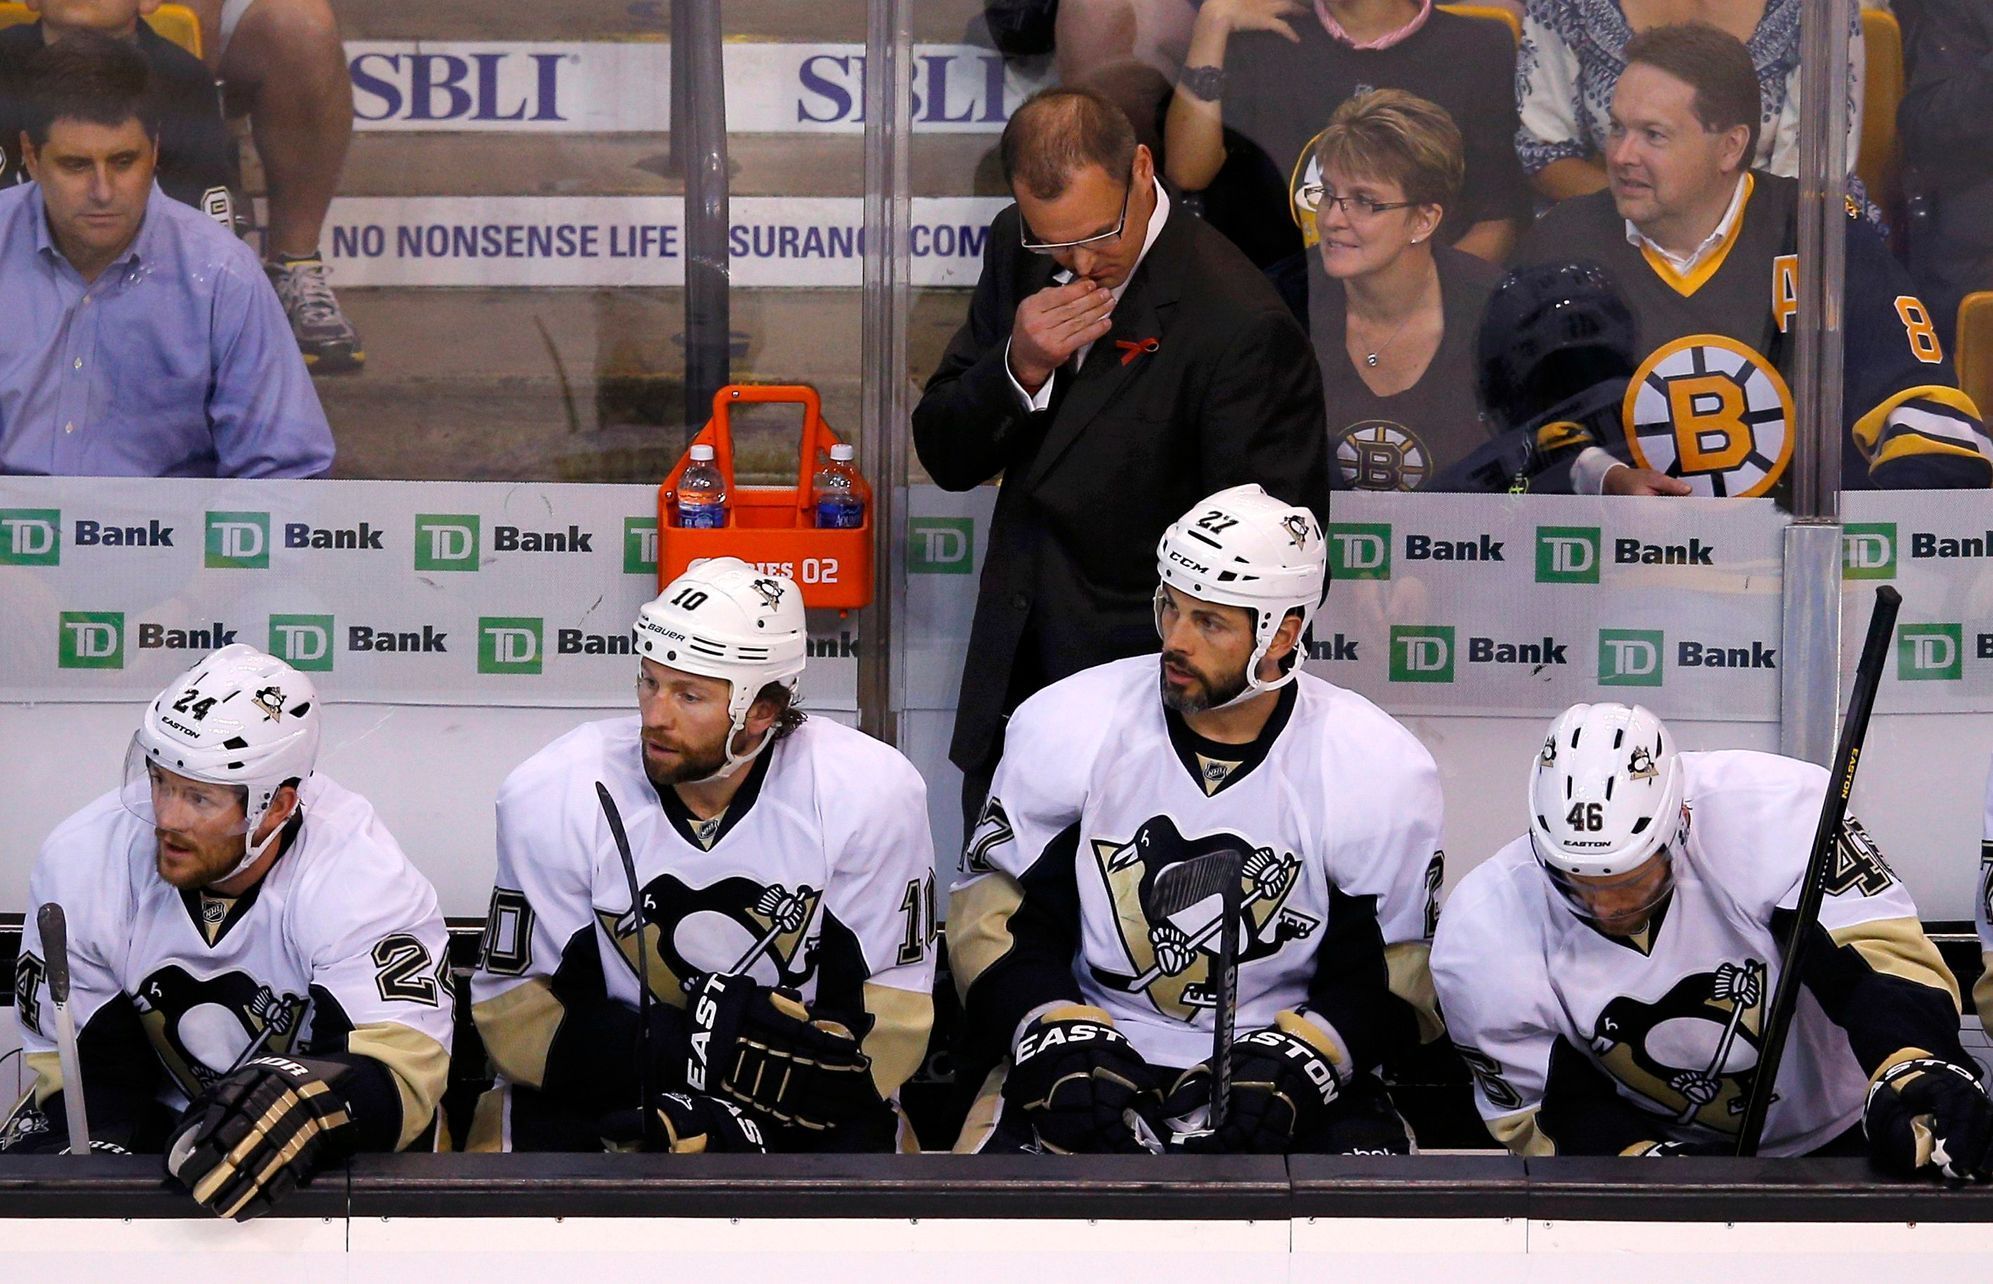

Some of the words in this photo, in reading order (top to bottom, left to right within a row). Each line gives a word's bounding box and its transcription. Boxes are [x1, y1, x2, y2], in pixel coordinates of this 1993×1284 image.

[350, 53, 568, 121] SBLI
[332, 225, 386, 257] NO
[397, 224, 599, 257] NONSENSE
[609, 225, 678, 257] LIFE
[1893, 296, 1943, 364] 8
[1, 519, 54, 554] TD
[75, 520, 174, 548] Bank
[1196, 510, 1240, 535] 27
[212, 523, 264, 558] TD
[285, 523, 384, 550] Bank
[422, 526, 473, 561] TD
[494, 526, 593, 553] Bank
[915, 528, 968, 562] TD
[1333, 534, 1384, 568] TD
[1406, 535, 1505, 562] Bank
[1541, 537, 1594, 571] TD
[1615, 539, 1714, 566] Bank
[1843, 533, 1890, 568] TD
[802, 558, 838, 584] 02
[1169, 551, 1209, 574] CCM
[670, 587, 709, 611] 10
[65, 622, 117, 657] TD
[138, 622, 238, 650] Bank
[275, 625, 327, 660] TD
[348, 625, 448, 653] Bank
[484, 628, 536, 663] TD
[1311, 633, 1359, 660] nk
[1396, 637, 1448, 671] TD
[1469, 637, 1568, 665] Bank
[1903, 634, 1956, 669] TD
[1604, 640, 1656, 674] TD
[1678, 641, 1777, 668] Bank
[172, 688, 218, 721] 24
[161, 716, 200, 740] EASTON
[1841, 747, 1859, 799] EASTON
[1566, 802, 1603, 832] 46
[1563, 840, 1612, 848] EASTON
[687, 973, 727, 1092] EAST
[1015, 1024, 1135, 1066] EAST
